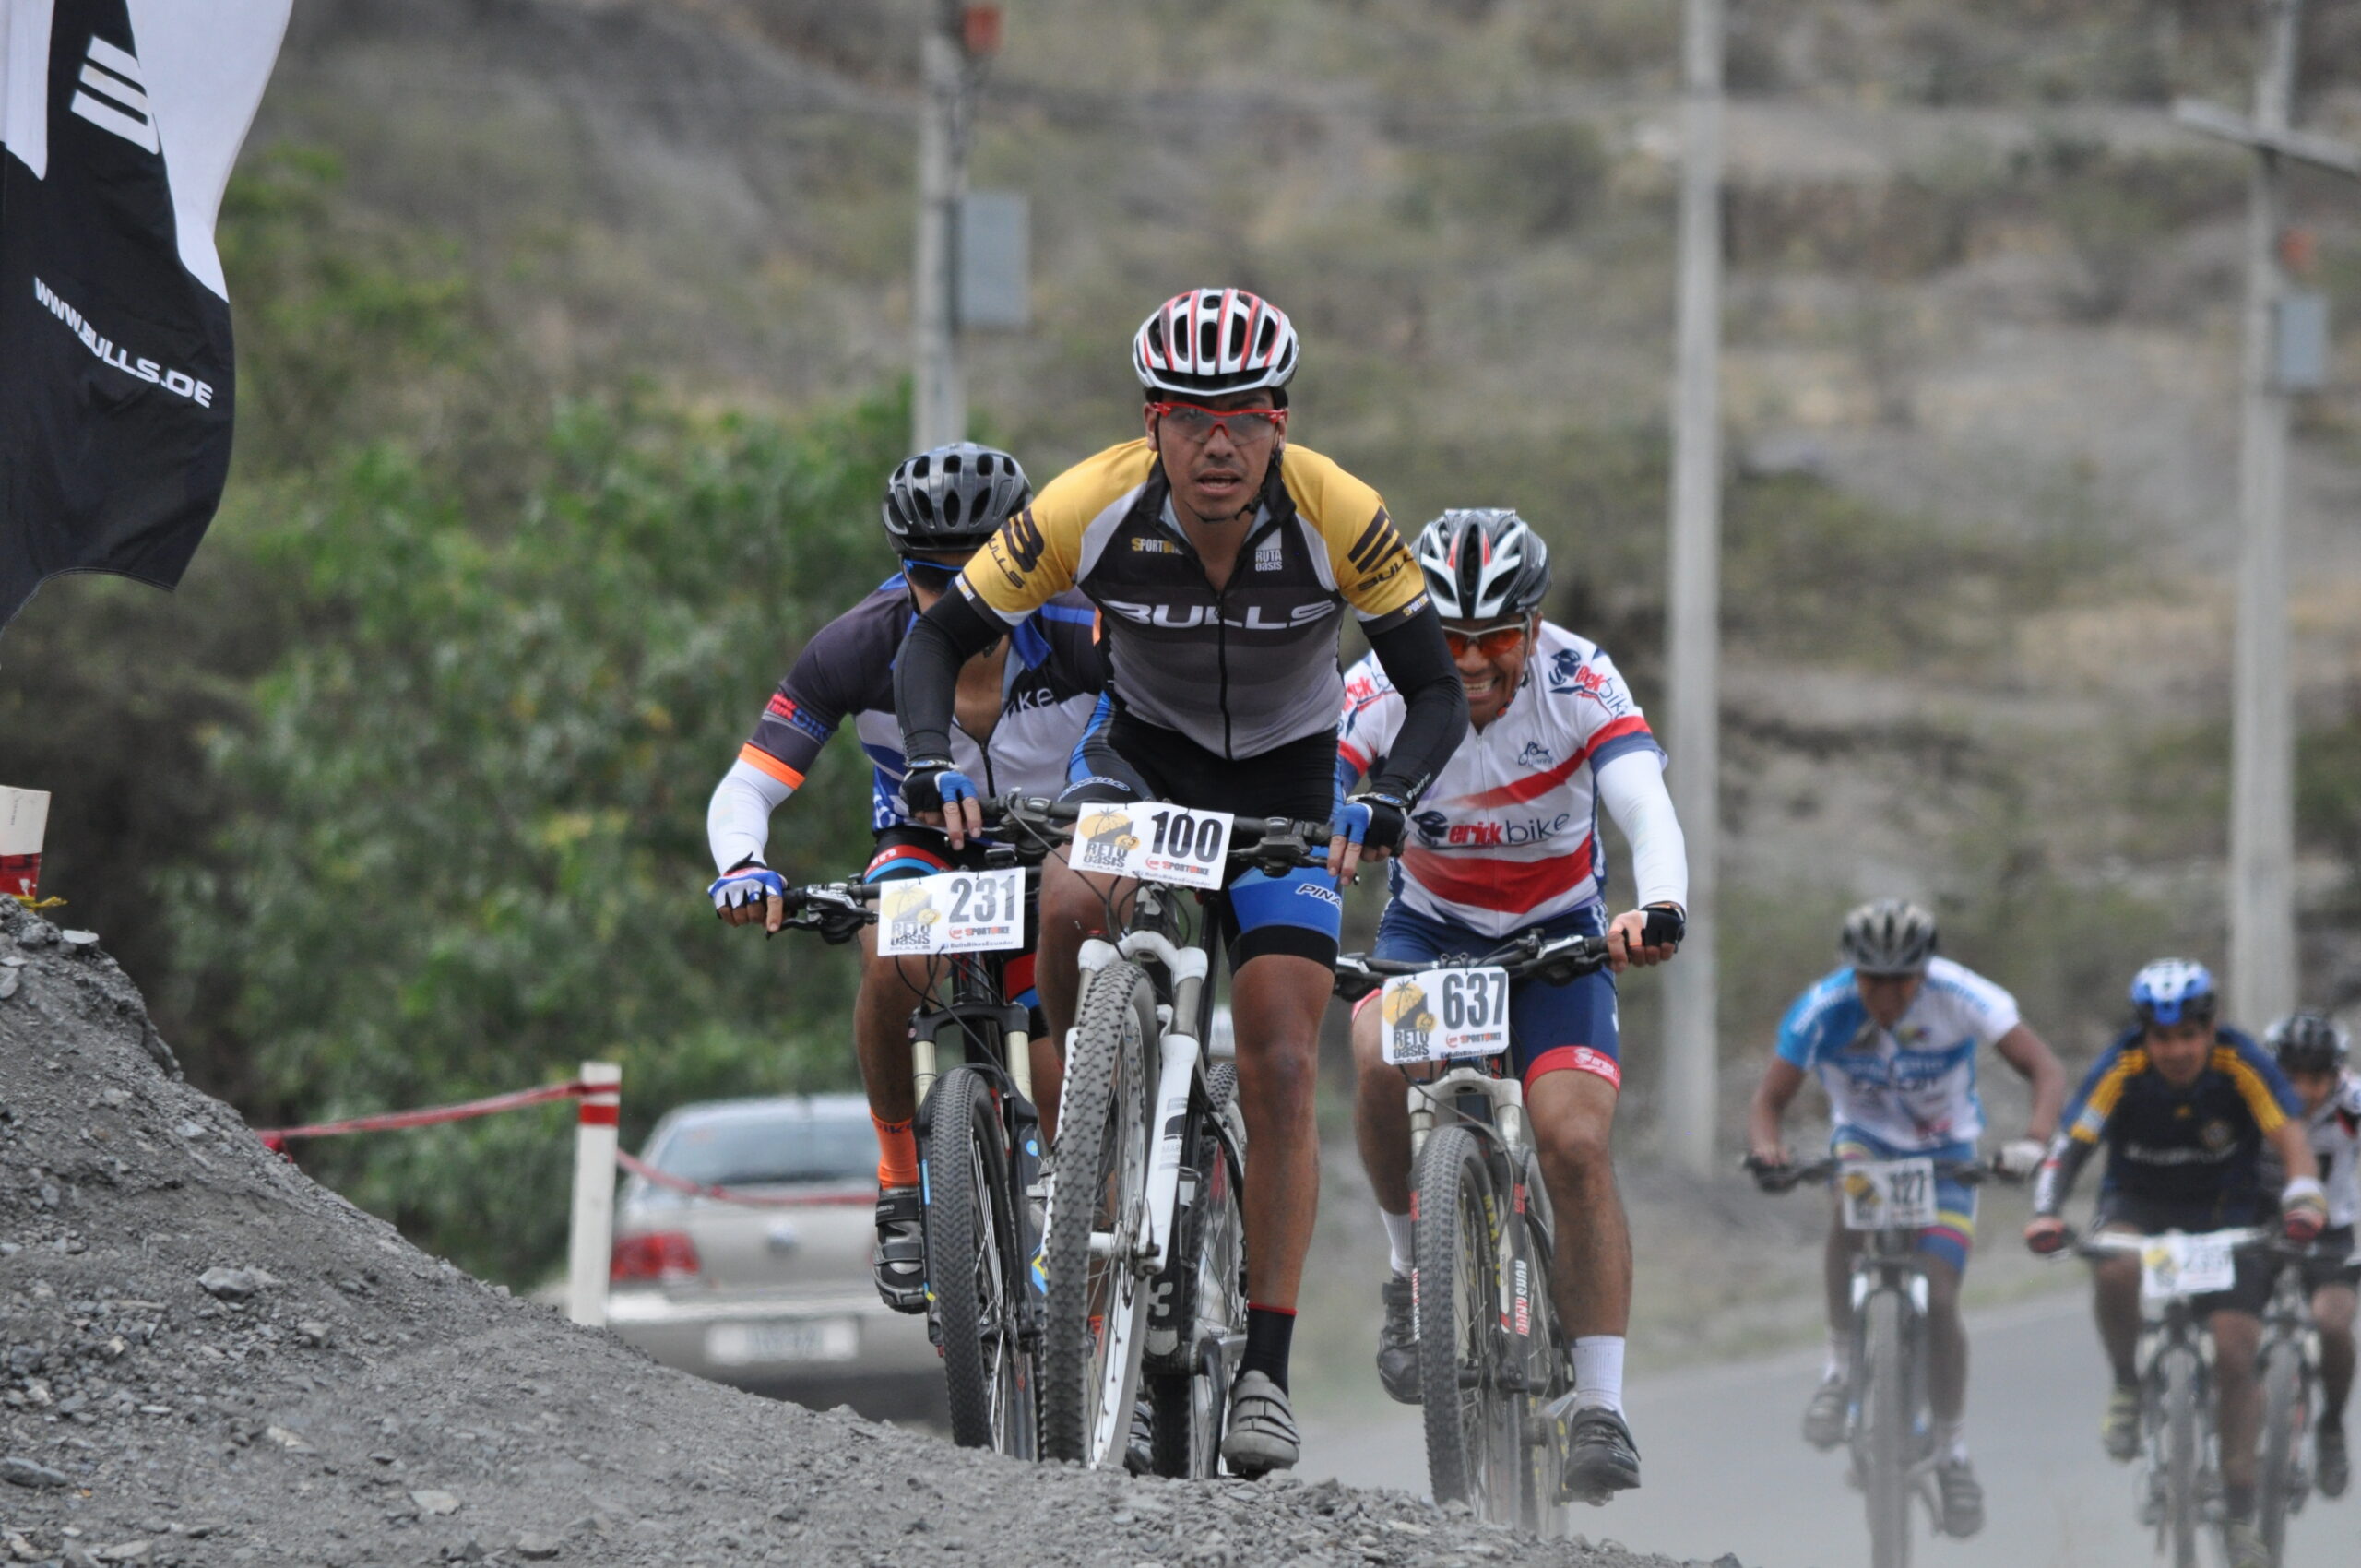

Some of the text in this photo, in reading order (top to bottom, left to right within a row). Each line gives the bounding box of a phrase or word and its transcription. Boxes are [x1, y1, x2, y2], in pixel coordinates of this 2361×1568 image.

[35, 276, 213, 409] WWW.BULLS.DE
[988, 537, 1026, 589] ULLS
[1255, 549, 1283, 562] RUTA
[1358, 553, 1414, 591] BULL
[1102, 600, 1336, 630] BULLS
[1151, 811, 1223, 864] 100
[1505, 813, 1571, 844] bike
[949, 875, 1015, 923] 231
[1295, 883, 1343, 908] PINA
[1442, 972, 1507, 1029] 637
